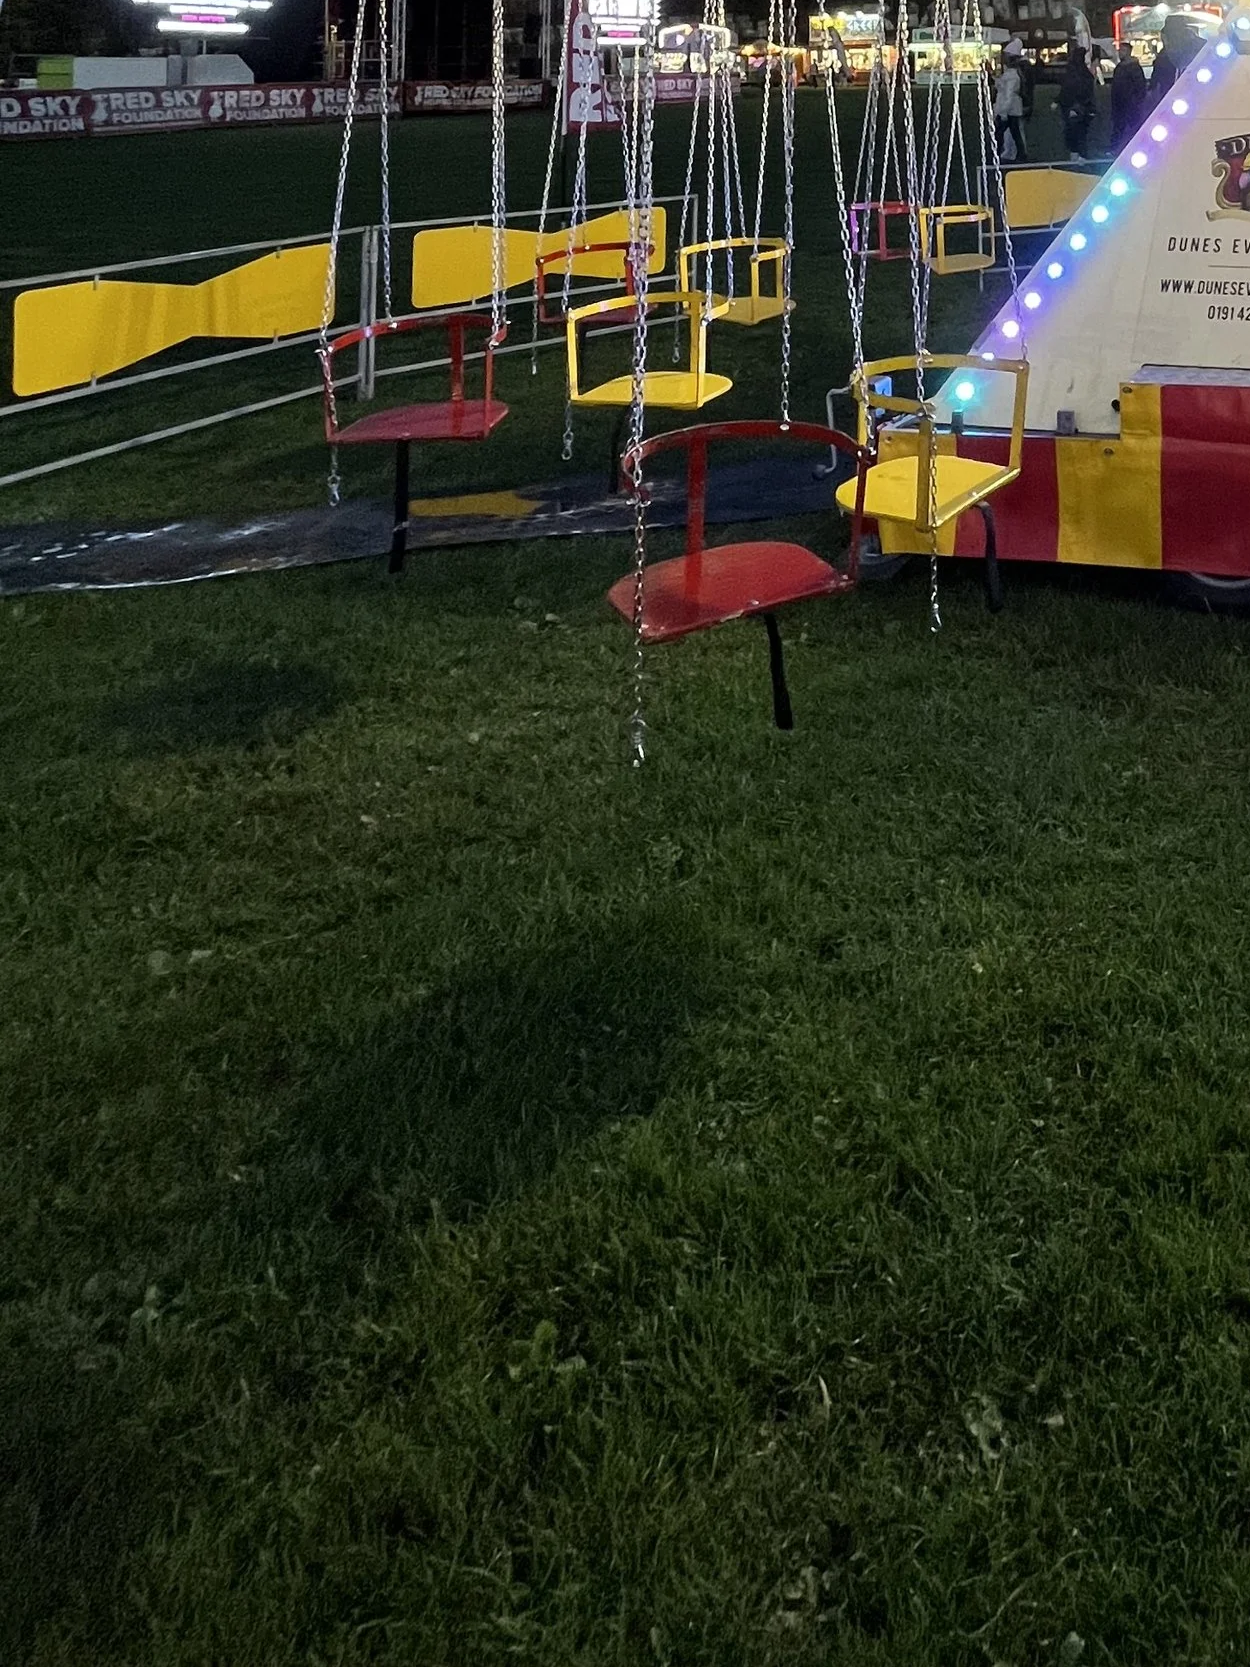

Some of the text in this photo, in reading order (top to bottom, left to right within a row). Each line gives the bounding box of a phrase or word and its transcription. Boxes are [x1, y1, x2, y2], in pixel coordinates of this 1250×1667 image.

[28, 95, 82, 116] SKY
[109, 90, 201, 110] RED SKY
[225, 88, 306, 108] RED SKY
[112, 108, 203, 124] FOUNDATION
[225, 107, 305, 121] FOUNDATION
[1168, 237, 1222, 253] DUNES
